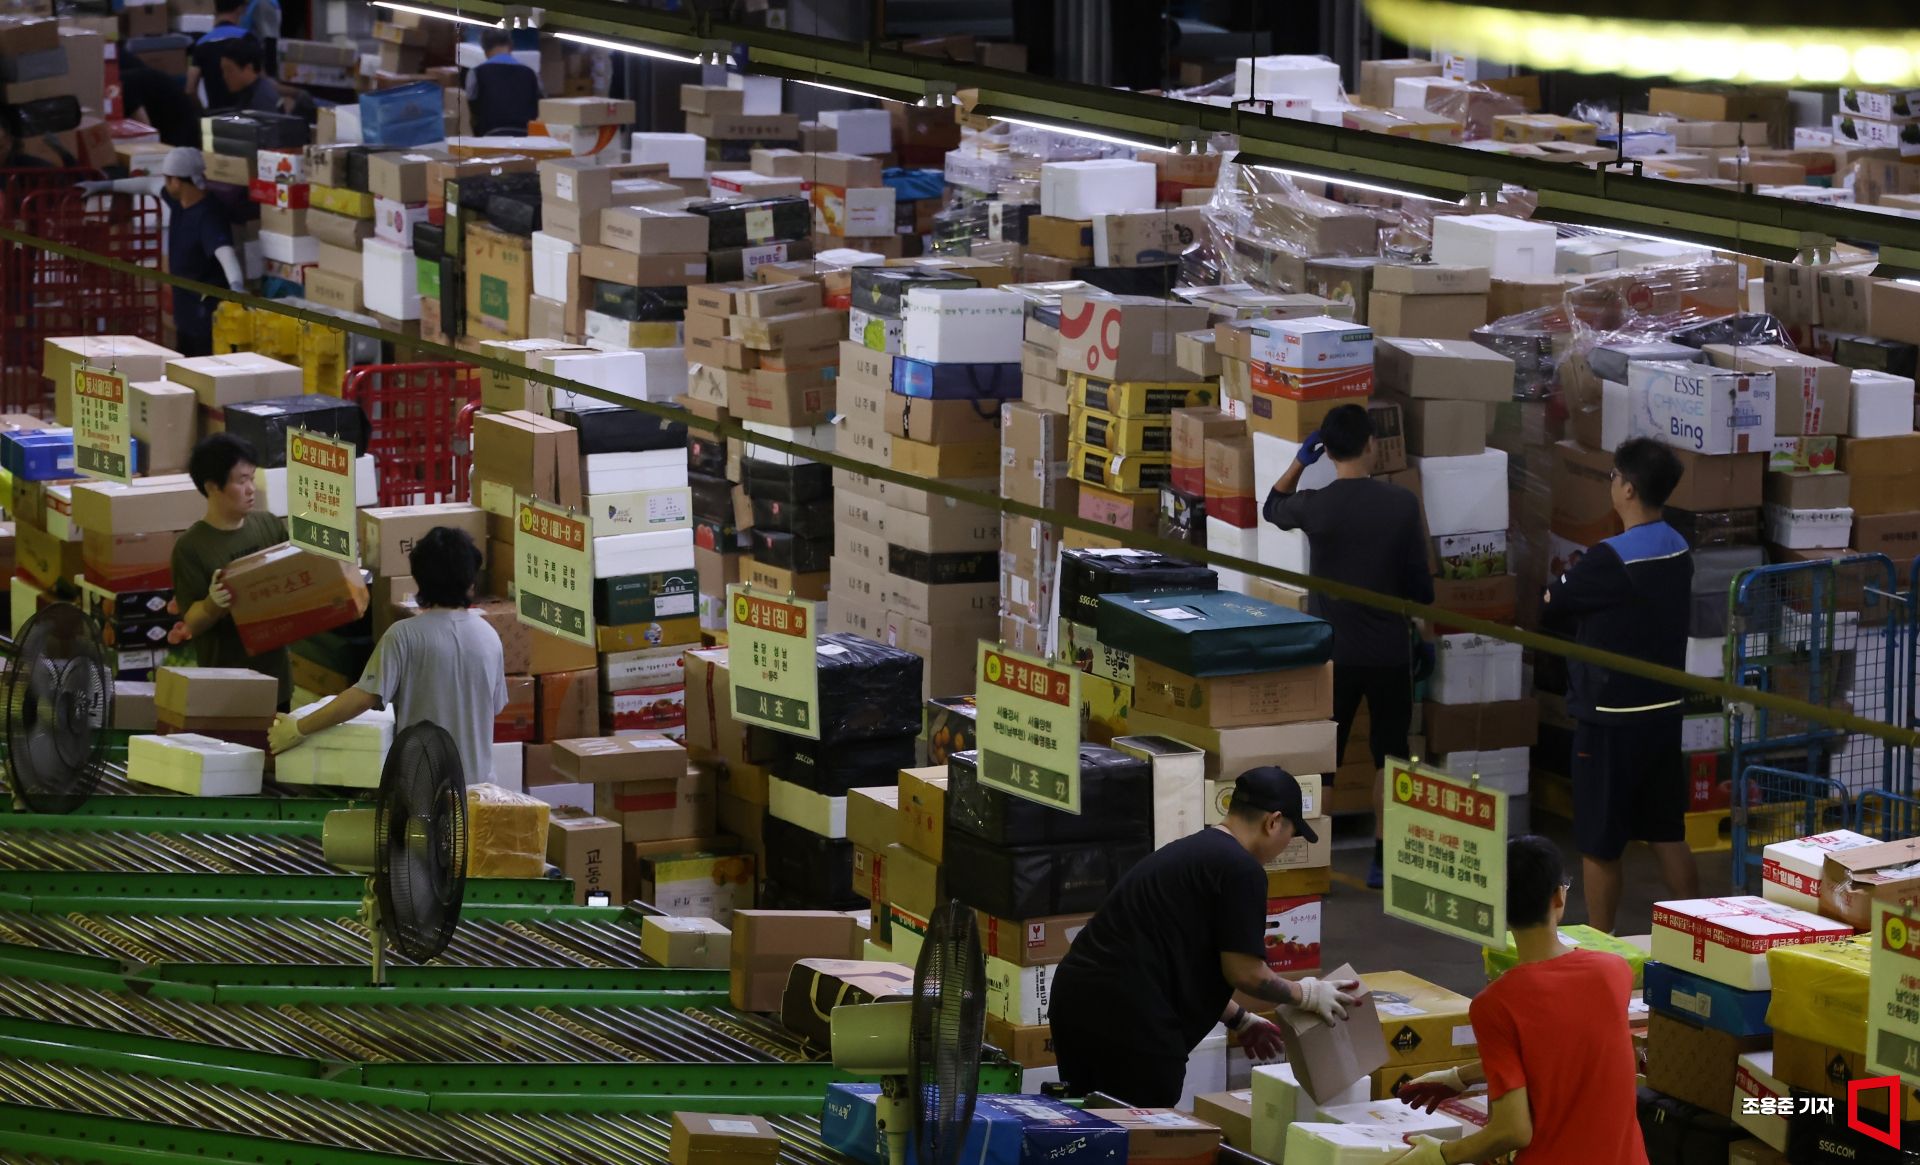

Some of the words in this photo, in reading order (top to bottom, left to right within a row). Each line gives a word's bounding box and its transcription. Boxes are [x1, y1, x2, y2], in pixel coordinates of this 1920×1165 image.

[1675, 375, 1704, 397] ESSE
[1653, 393, 1704, 417] CHANGE
[1671, 416, 1703, 449] Bing
[750, 602, 788, 630] 성남(집)
[1004, 662, 1048, 696] 부천(집)
[1056, 681, 1066, 696] 27
[1056, 780, 1065, 795] 27
[1404, 838, 1425, 854] 남인천
[1459, 854, 1481, 872] 서인천
[1463, 840, 1478, 855] 인천
[1397, 849, 1425, 870] 인천계양
[1426, 860, 1440, 874] 부평
[1441, 864, 1456, 880] 시흥
[1457, 868, 1471, 883] 강화
[1772, 867, 1803, 890] 당일배송
[1818, 1139, 1857, 1161] SSG.COM
